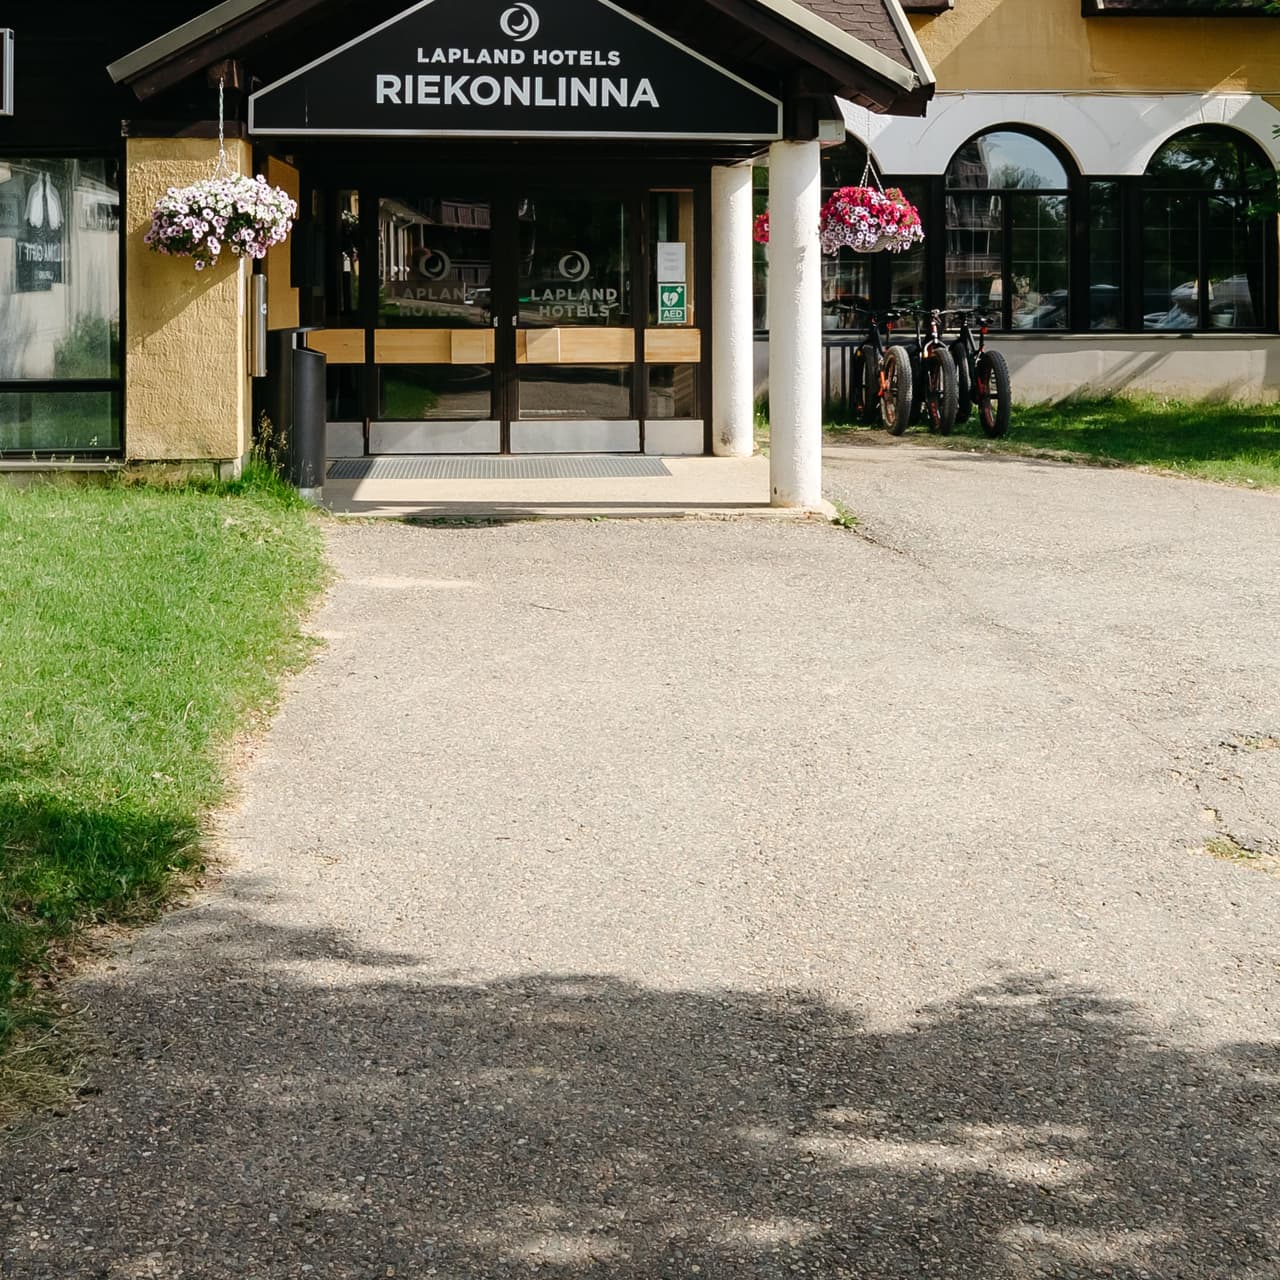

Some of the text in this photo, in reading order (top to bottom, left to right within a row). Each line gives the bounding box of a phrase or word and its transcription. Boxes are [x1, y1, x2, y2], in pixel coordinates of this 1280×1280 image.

[417, 47, 621, 67] LAPLAND HOTELS
[375, 74, 660, 108] RIEKONLINNA
[531, 288, 618, 301] LAPLAND
[540, 305, 610, 318] HOTELS
[663, 310, 683, 318] AED
